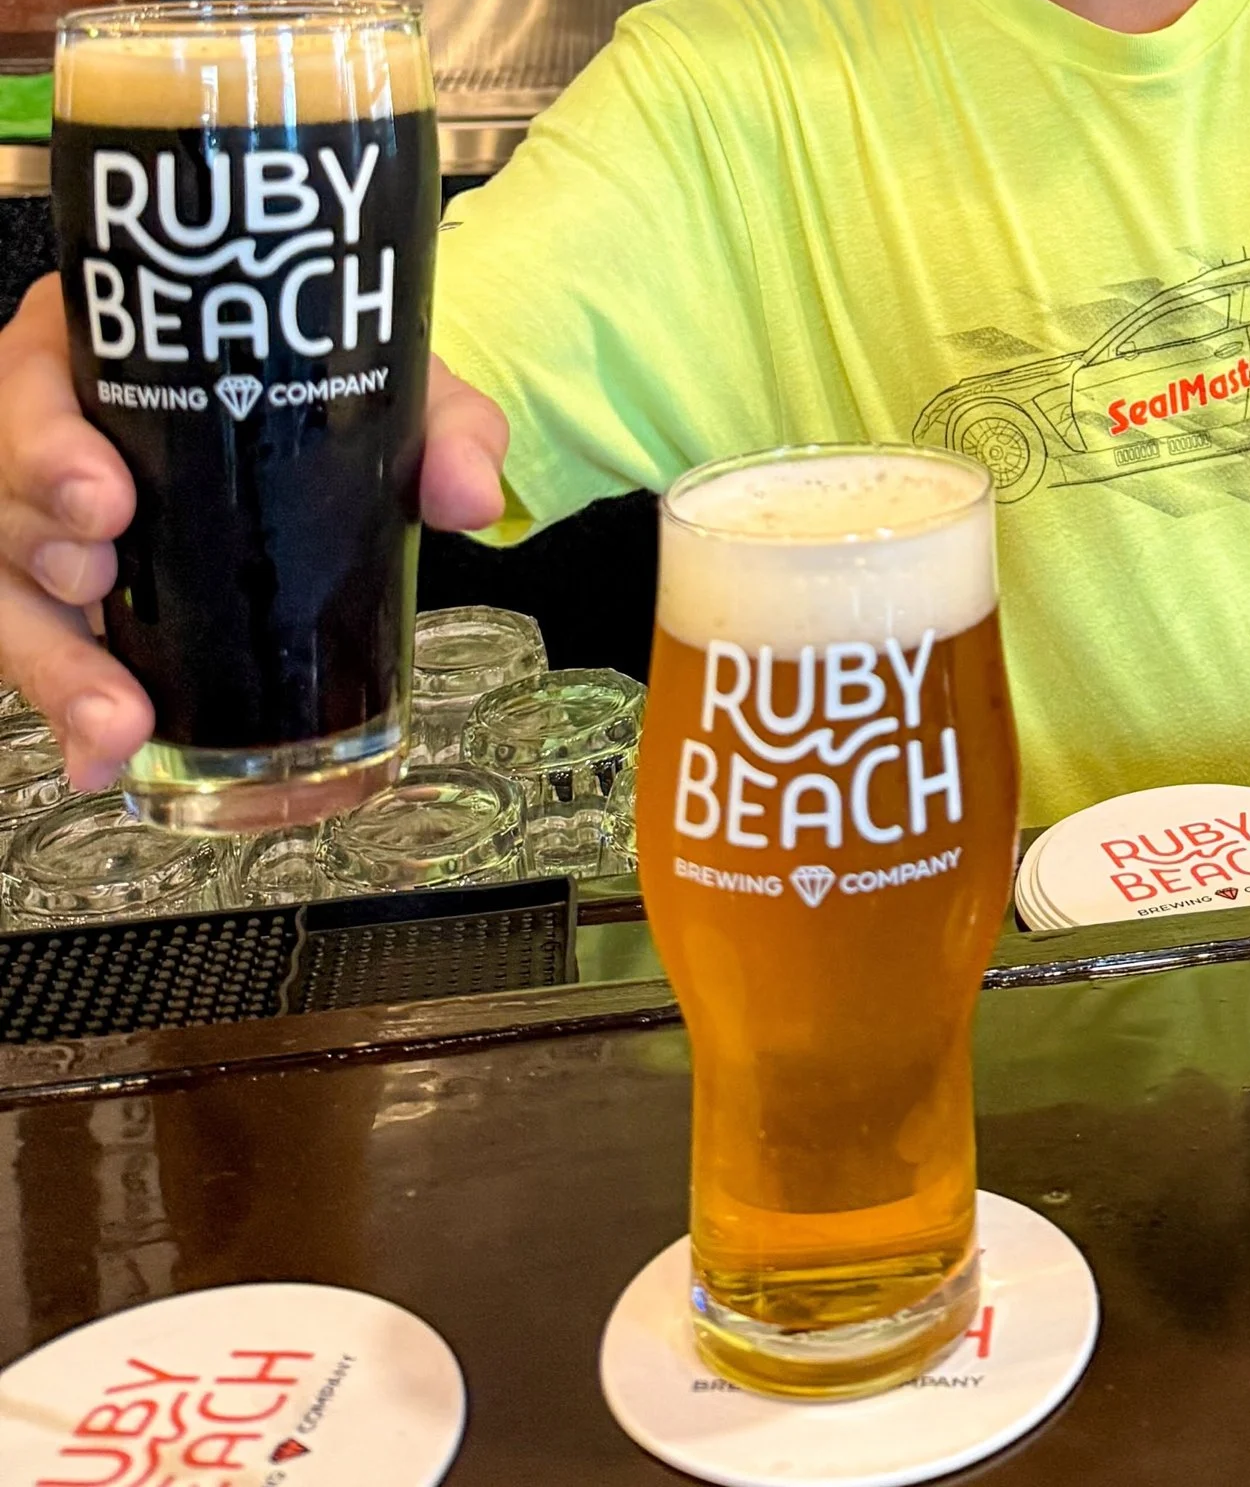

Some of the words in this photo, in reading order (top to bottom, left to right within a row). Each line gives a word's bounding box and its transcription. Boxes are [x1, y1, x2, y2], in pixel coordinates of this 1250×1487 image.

[93, 143, 380, 277] RUBY
[83, 247, 394, 362] BEACH
[97, 380, 208, 410] BREWING
[268, 368, 389, 407] COMPANY
[701, 628, 936, 766] RUBY
[674, 727, 962, 850] BEACH
[674, 856, 783, 897] BREWING
[839, 847, 962, 895] COMPANY
[1137, 894, 1213, 917] BREWING
[36, 1359, 199, 1487] UBY
